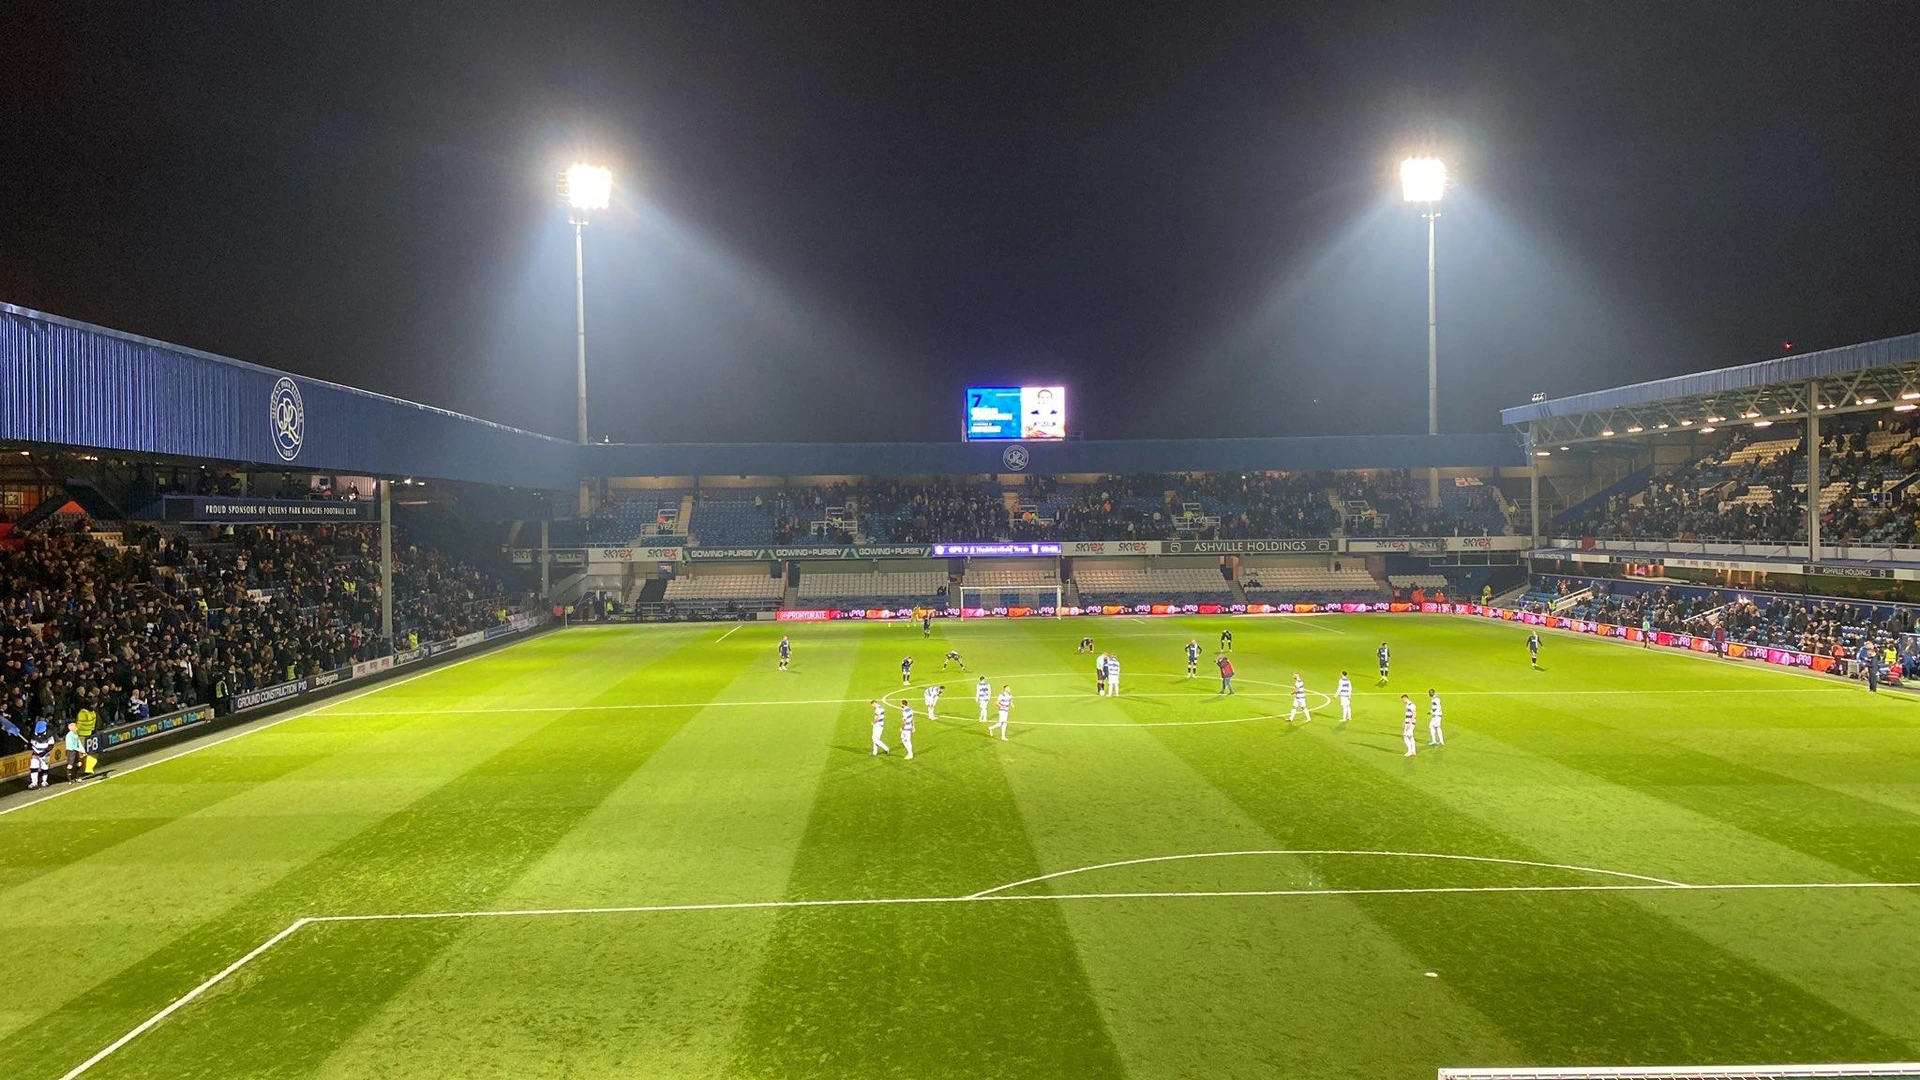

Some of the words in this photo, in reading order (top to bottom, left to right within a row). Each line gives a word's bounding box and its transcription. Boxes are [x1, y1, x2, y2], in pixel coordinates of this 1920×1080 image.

[972, 395, 982, 407] 7
[205, 505, 227, 514] PROUD
[228, 505, 257, 514] SPONSORS
[258, 506, 266, 514] OF
[267, 506, 287, 515] QUEENS
[288, 506, 300, 514] PARK
[302, 506, 322, 515] RANGERS
[323, 507, 344, 515] FOOTBALL
[345, 507, 356, 515] CLUB
[1194, 542, 1243, 552] ASHVILLE
[1247, 541, 1306, 551] HOLDINGS
[1823, 567, 1844, 575] ASHVILLE
[1845, 568, 1871, 577] HOLDINGS
[315, 673, 338, 685] Bridgegate
[298, 680, 307, 692] P10
[237, 693, 260, 708] GROUND
[260, 683, 298, 702] CONSTRUCTION
[86, 736, 99, 752] P8
